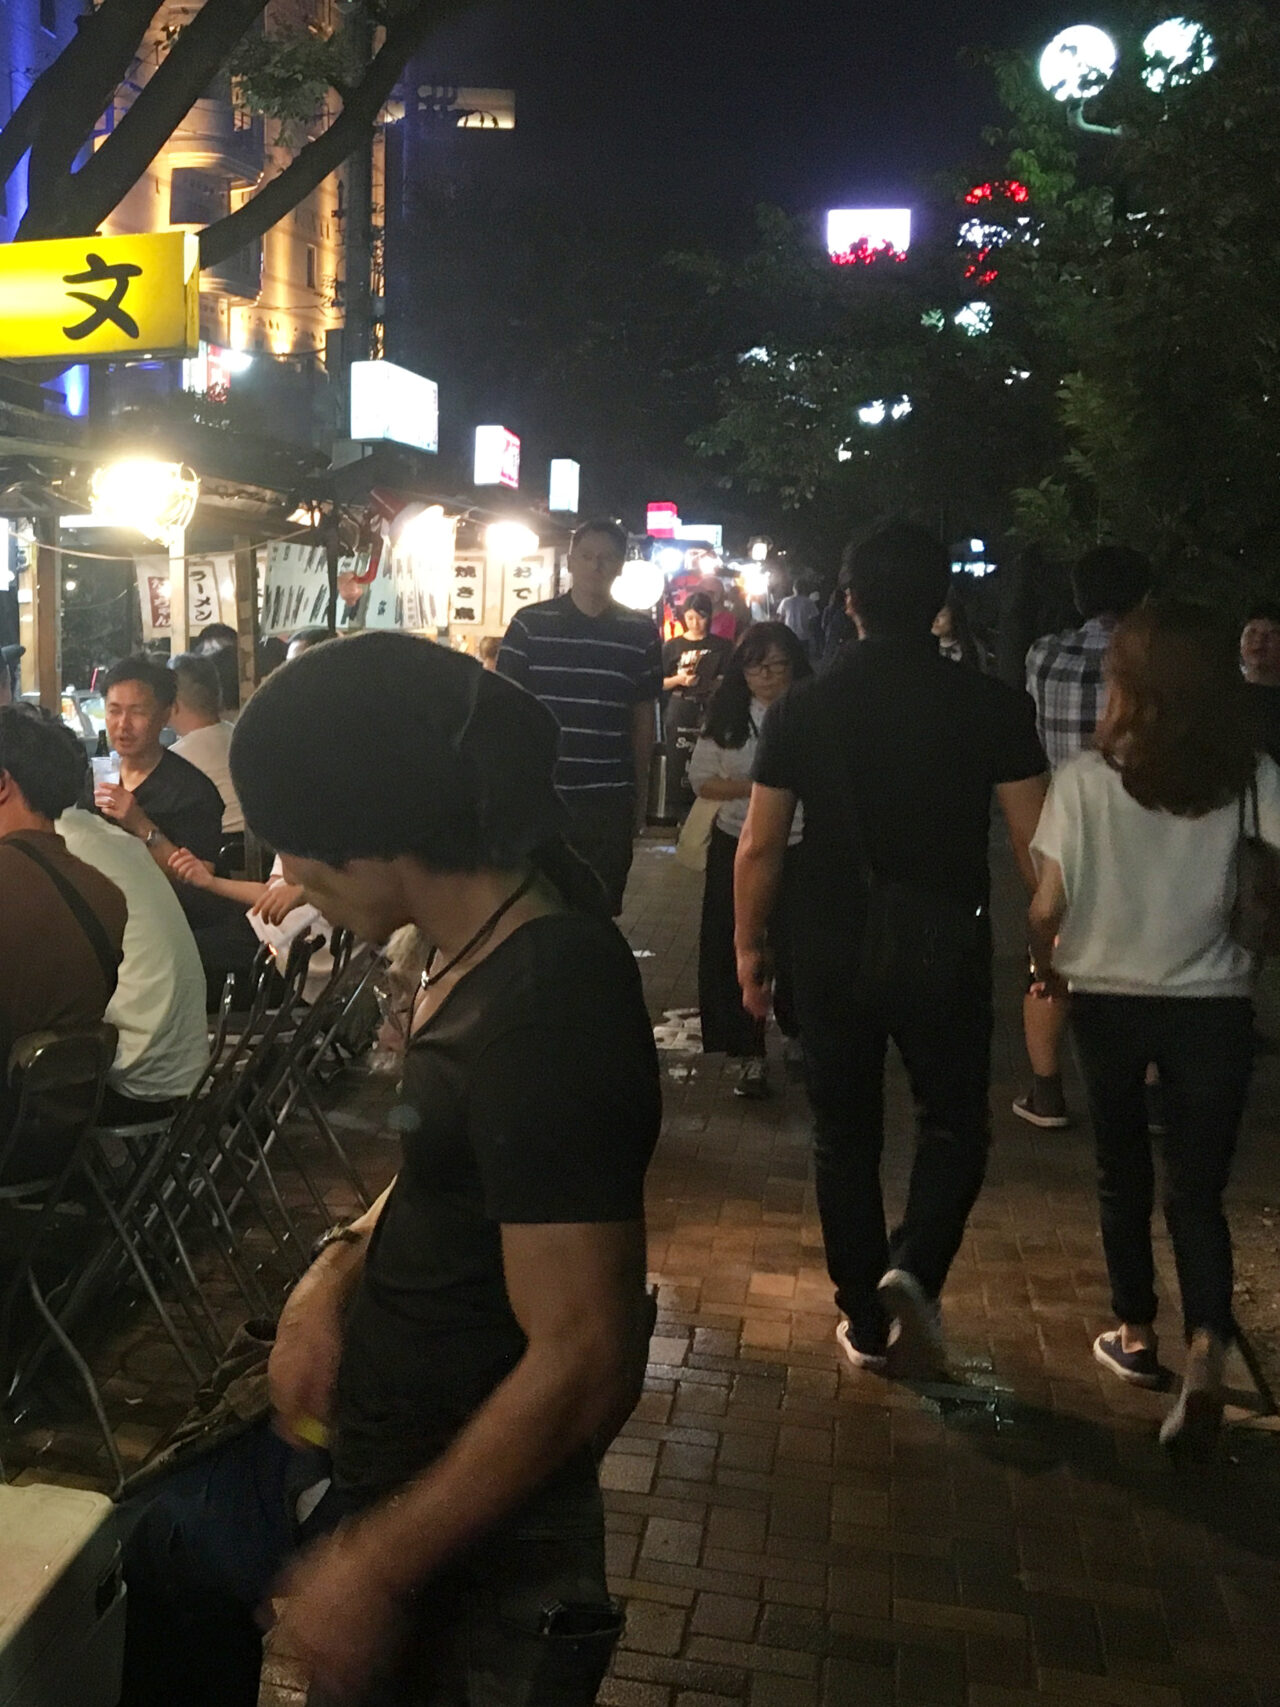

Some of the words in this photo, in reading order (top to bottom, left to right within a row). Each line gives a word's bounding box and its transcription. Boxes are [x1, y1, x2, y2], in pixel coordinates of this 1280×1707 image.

[190, 570, 213, 621] ラーメン
[512, 566, 533, 600] おで
